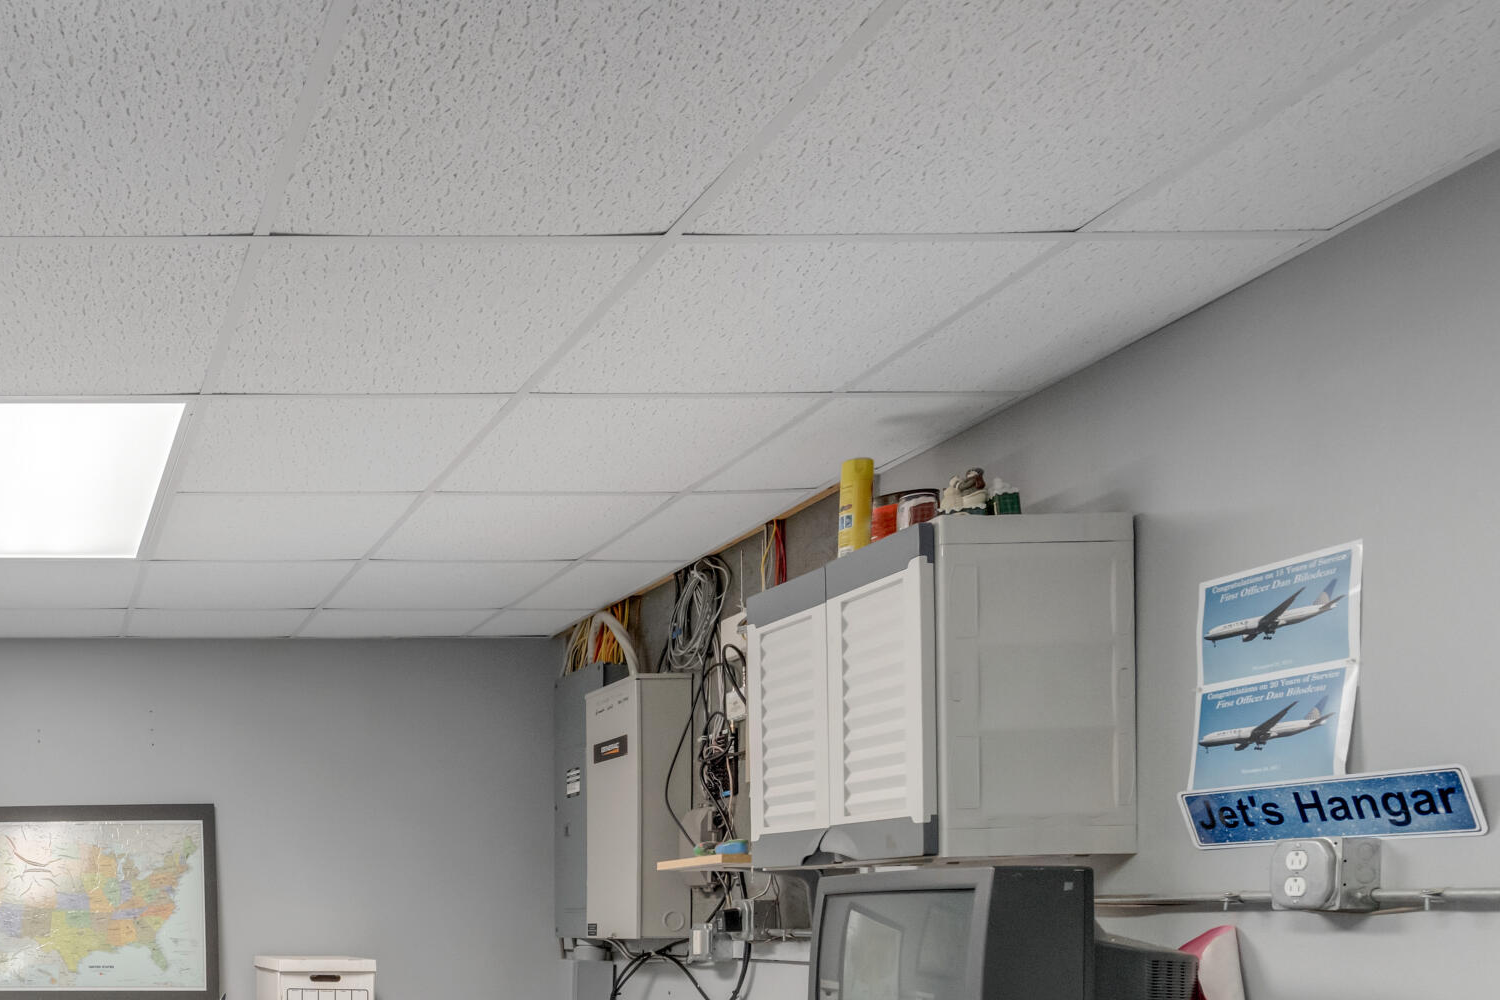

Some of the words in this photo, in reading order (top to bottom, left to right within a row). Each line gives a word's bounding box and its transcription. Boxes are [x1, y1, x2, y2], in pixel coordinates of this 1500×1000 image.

[1240, 584, 1270, 598] Officer
[1271, 578, 1291, 590] Dan
[1216, 699, 1234, 709] First
[1235, 694, 1265, 705] Officer
[1266, 690, 1284, 701] Dan
[1201, 796, 1285, 831] Jet's
[1292, 786, 1456, 827] Hangar
